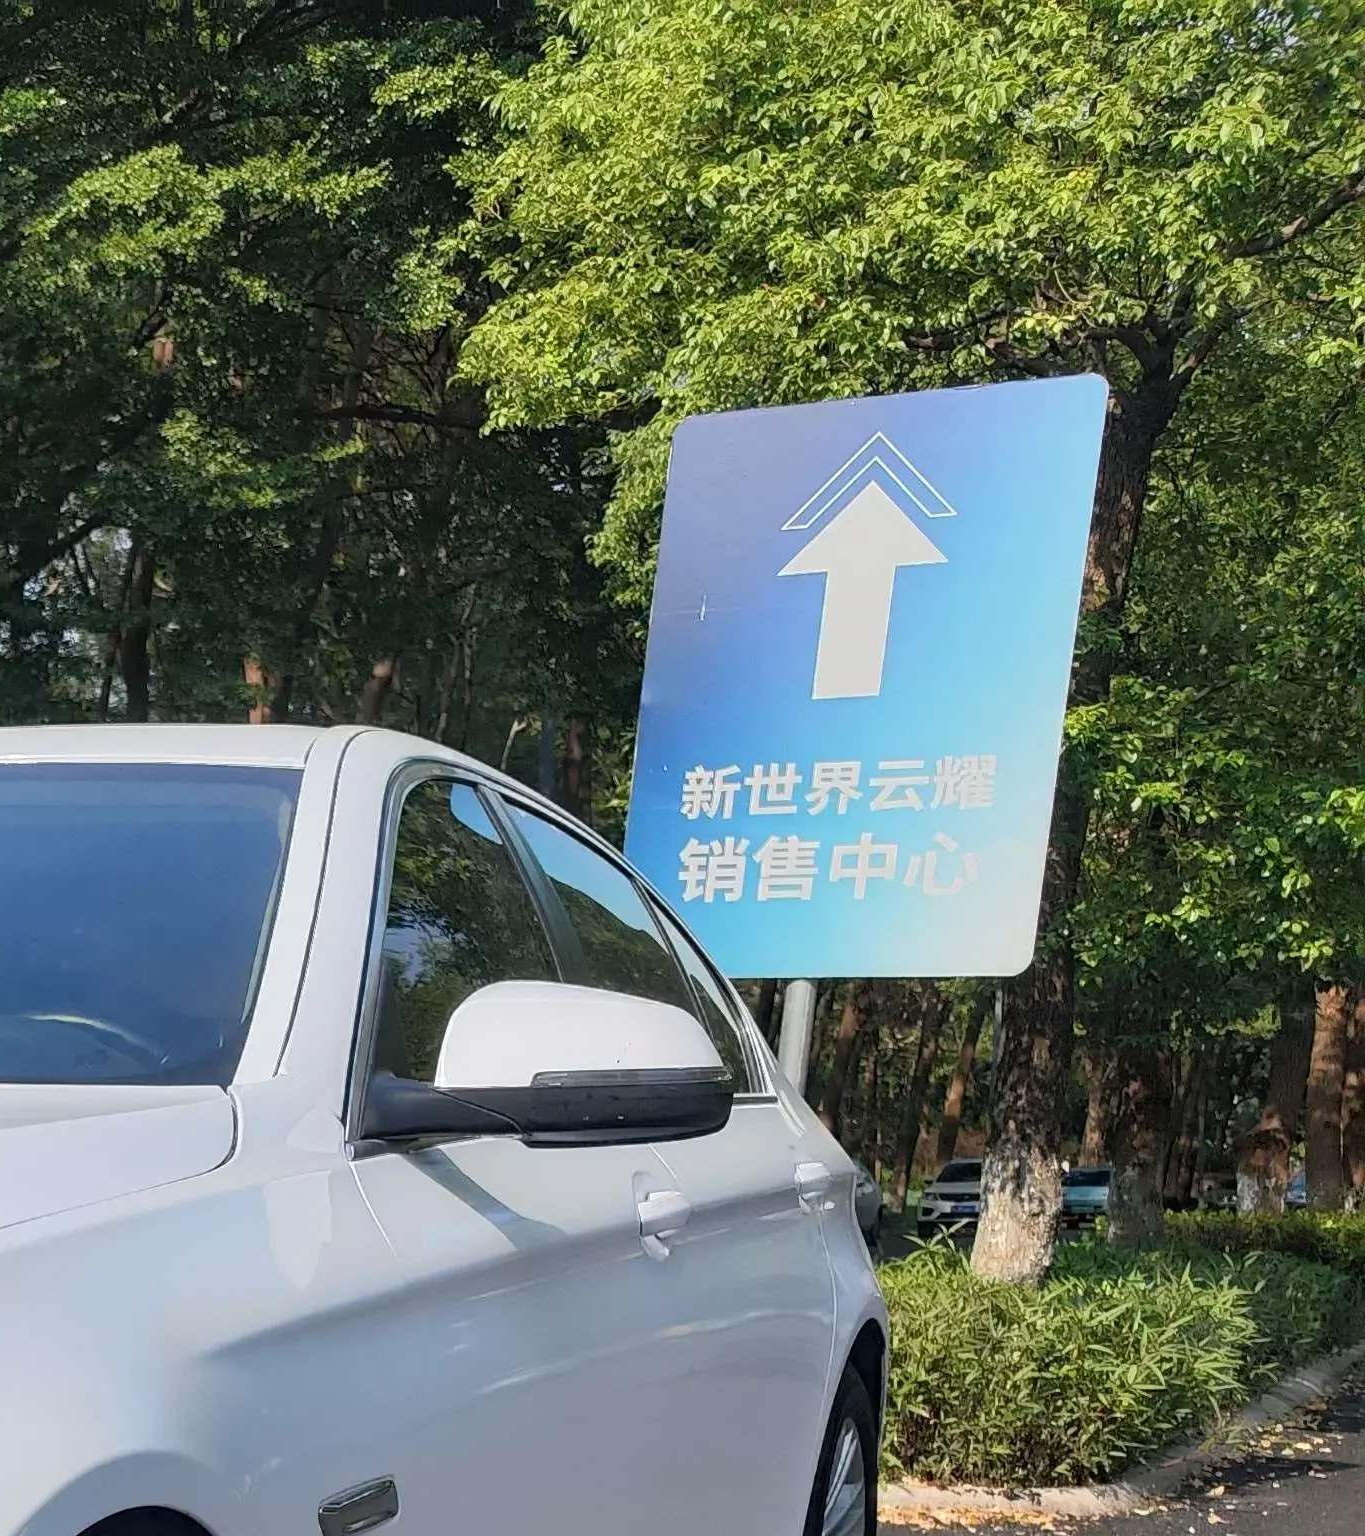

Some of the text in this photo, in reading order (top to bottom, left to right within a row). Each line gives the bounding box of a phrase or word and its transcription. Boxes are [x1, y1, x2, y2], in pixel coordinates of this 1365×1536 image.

[680, 754, 997, 820] 新世界云耀
[678, 831, 980, 903] 销售中心
